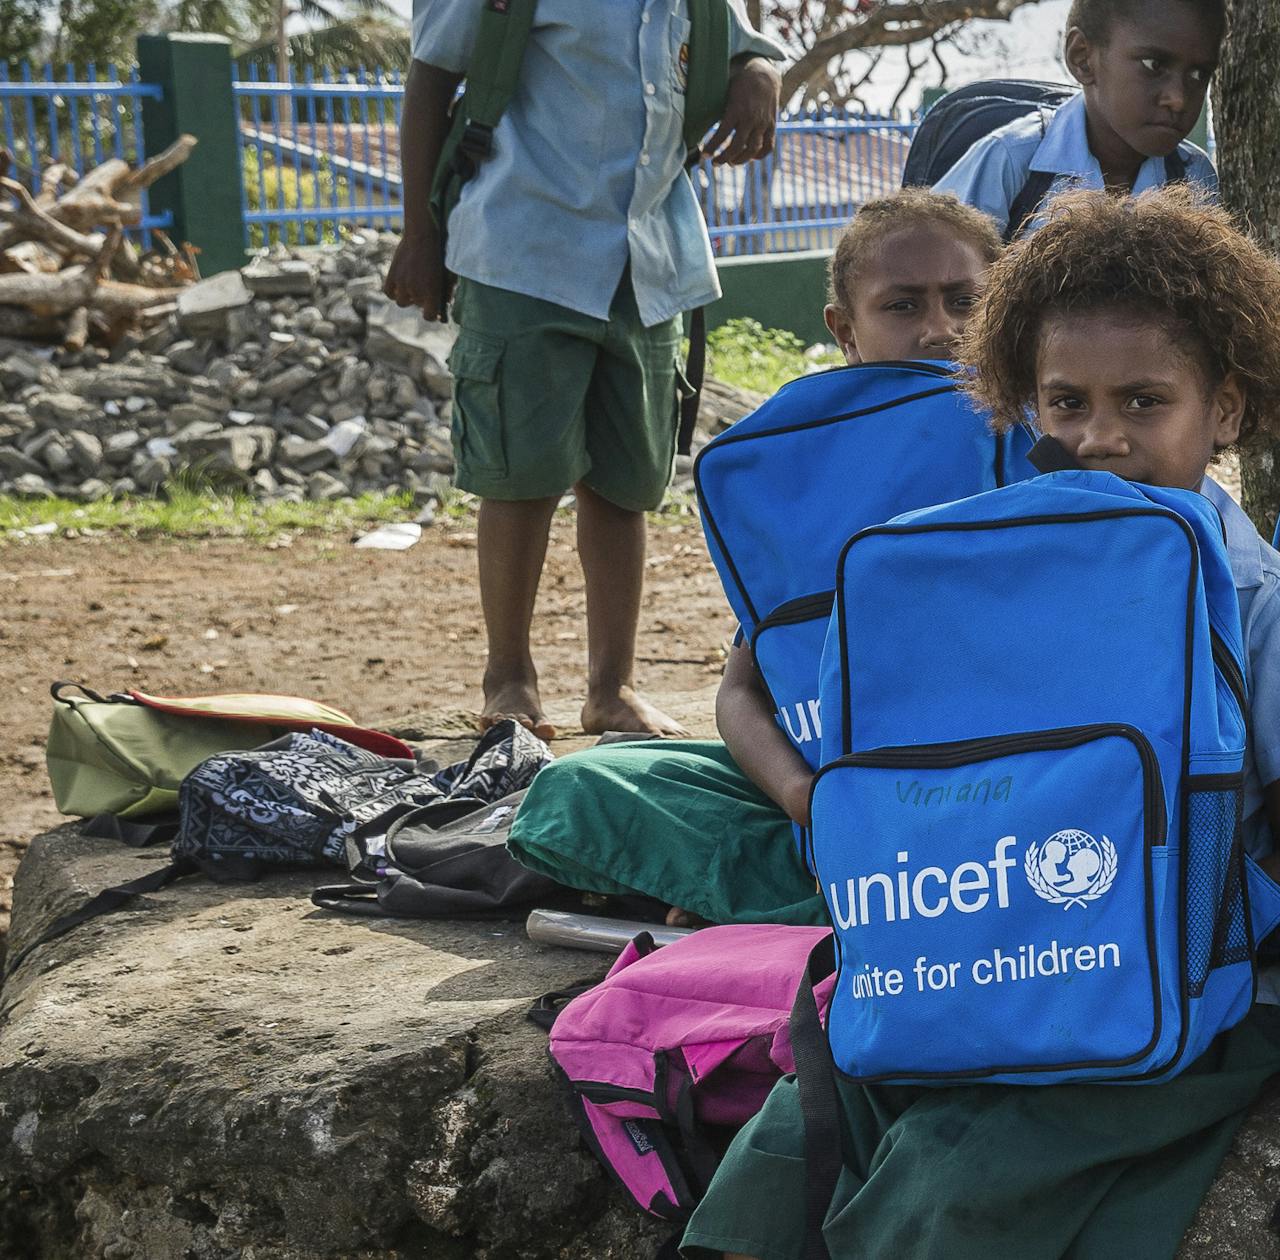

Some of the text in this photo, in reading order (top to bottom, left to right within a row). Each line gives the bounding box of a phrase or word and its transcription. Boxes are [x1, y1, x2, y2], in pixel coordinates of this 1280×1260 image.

[830, 835, 1017, 930] unicef
[853, 940, 1121, 999] unite for children
